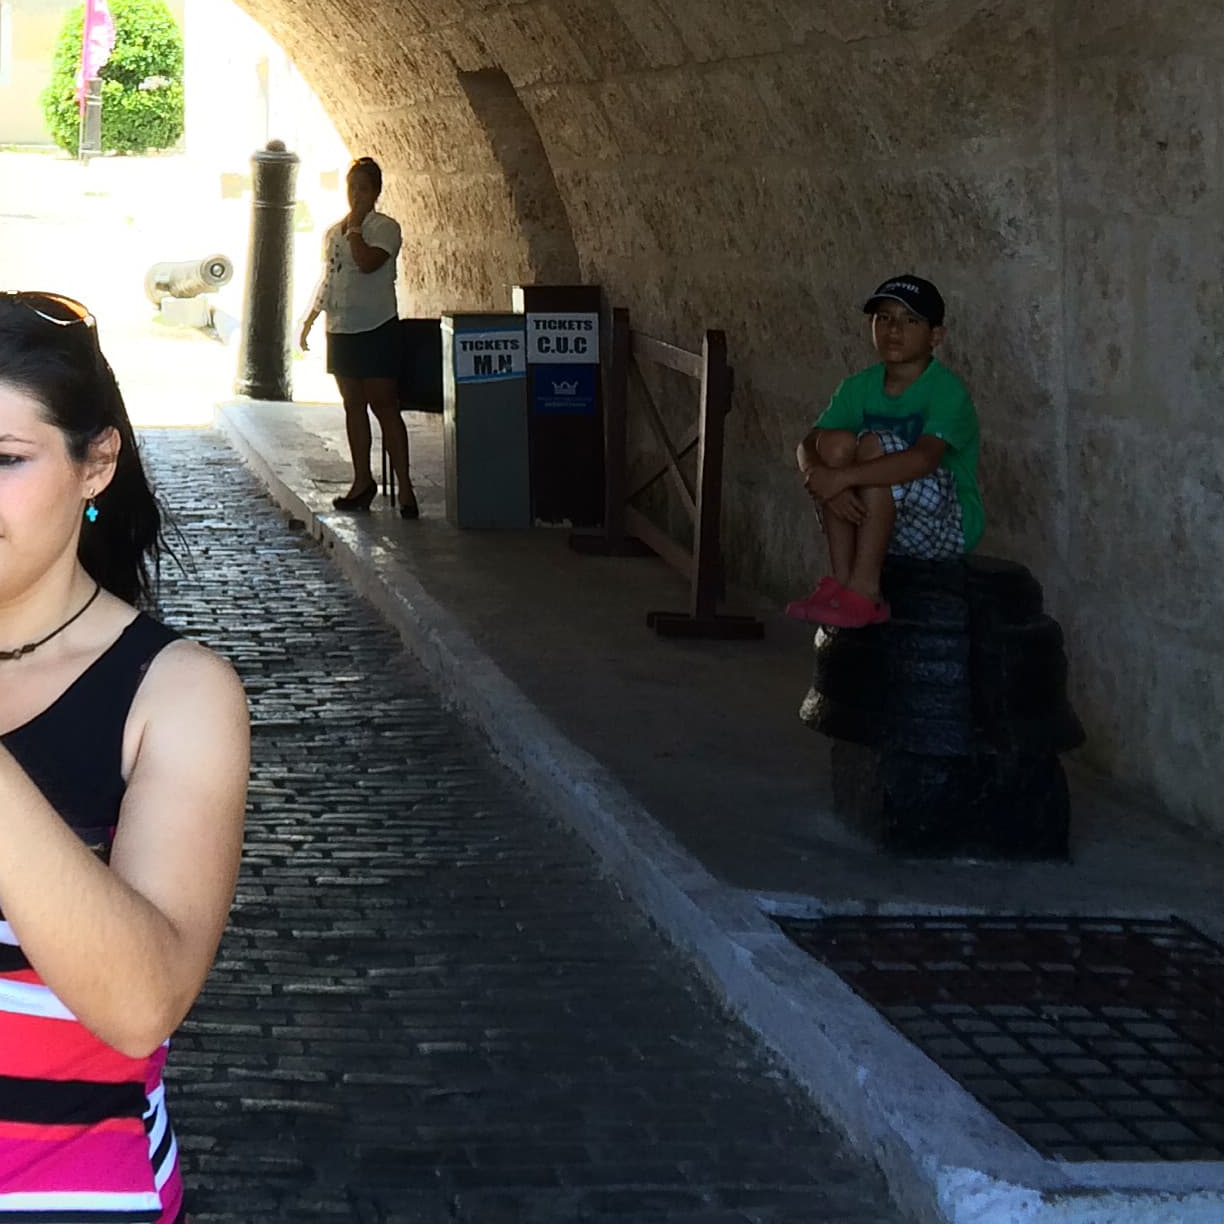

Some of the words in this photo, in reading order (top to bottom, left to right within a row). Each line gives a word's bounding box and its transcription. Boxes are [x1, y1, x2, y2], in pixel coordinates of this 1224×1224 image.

[533, 319, 593, 331] TICKETS
[460, 339, 520, 352] TICKETS
[537, 336, 587, 354] C.U.C
